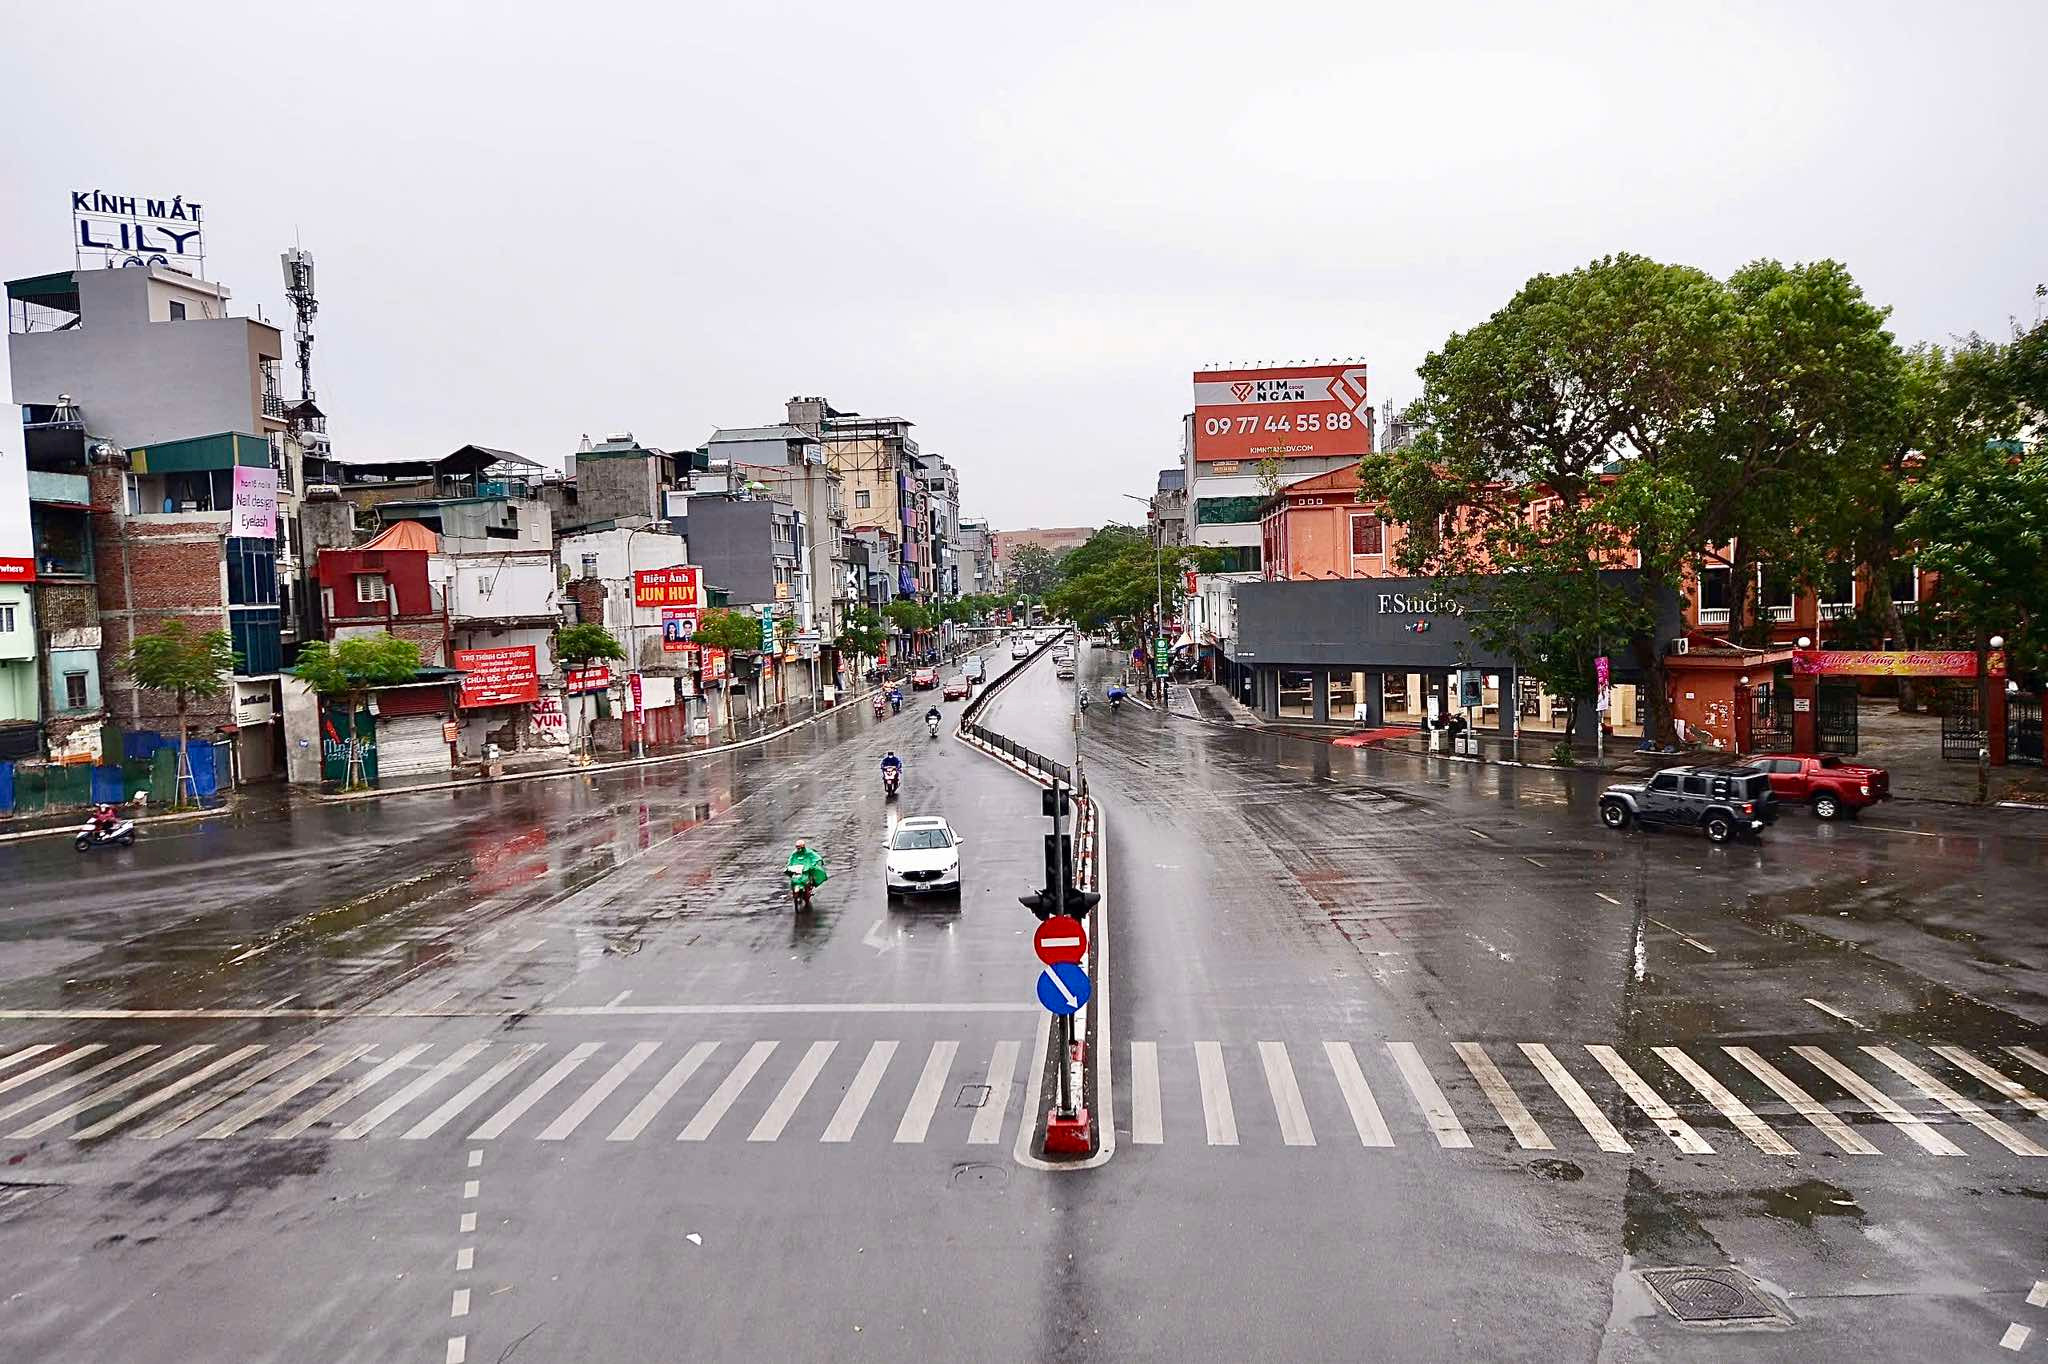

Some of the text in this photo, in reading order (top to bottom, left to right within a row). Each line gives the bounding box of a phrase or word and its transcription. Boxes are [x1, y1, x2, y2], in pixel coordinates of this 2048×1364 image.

[72, 190, 201, 221] KÍNH MẮT
[81, 220, 200, 254] LILY
[1257, 381, 1288, 391] KIM
[1257, 391, 1304, 401] NGAN
[1205, 411, 1352, 436] 09 77 44 55 88
[236, 493, 274, 511] Nail design
[242, 513, 268, 530] Eyelash
[643, 571, 689, 585] Hiệu Ảnh
[637, 586, 695, 601] JUN HUY
[1378, 592, 1457, 613] F.Studio
